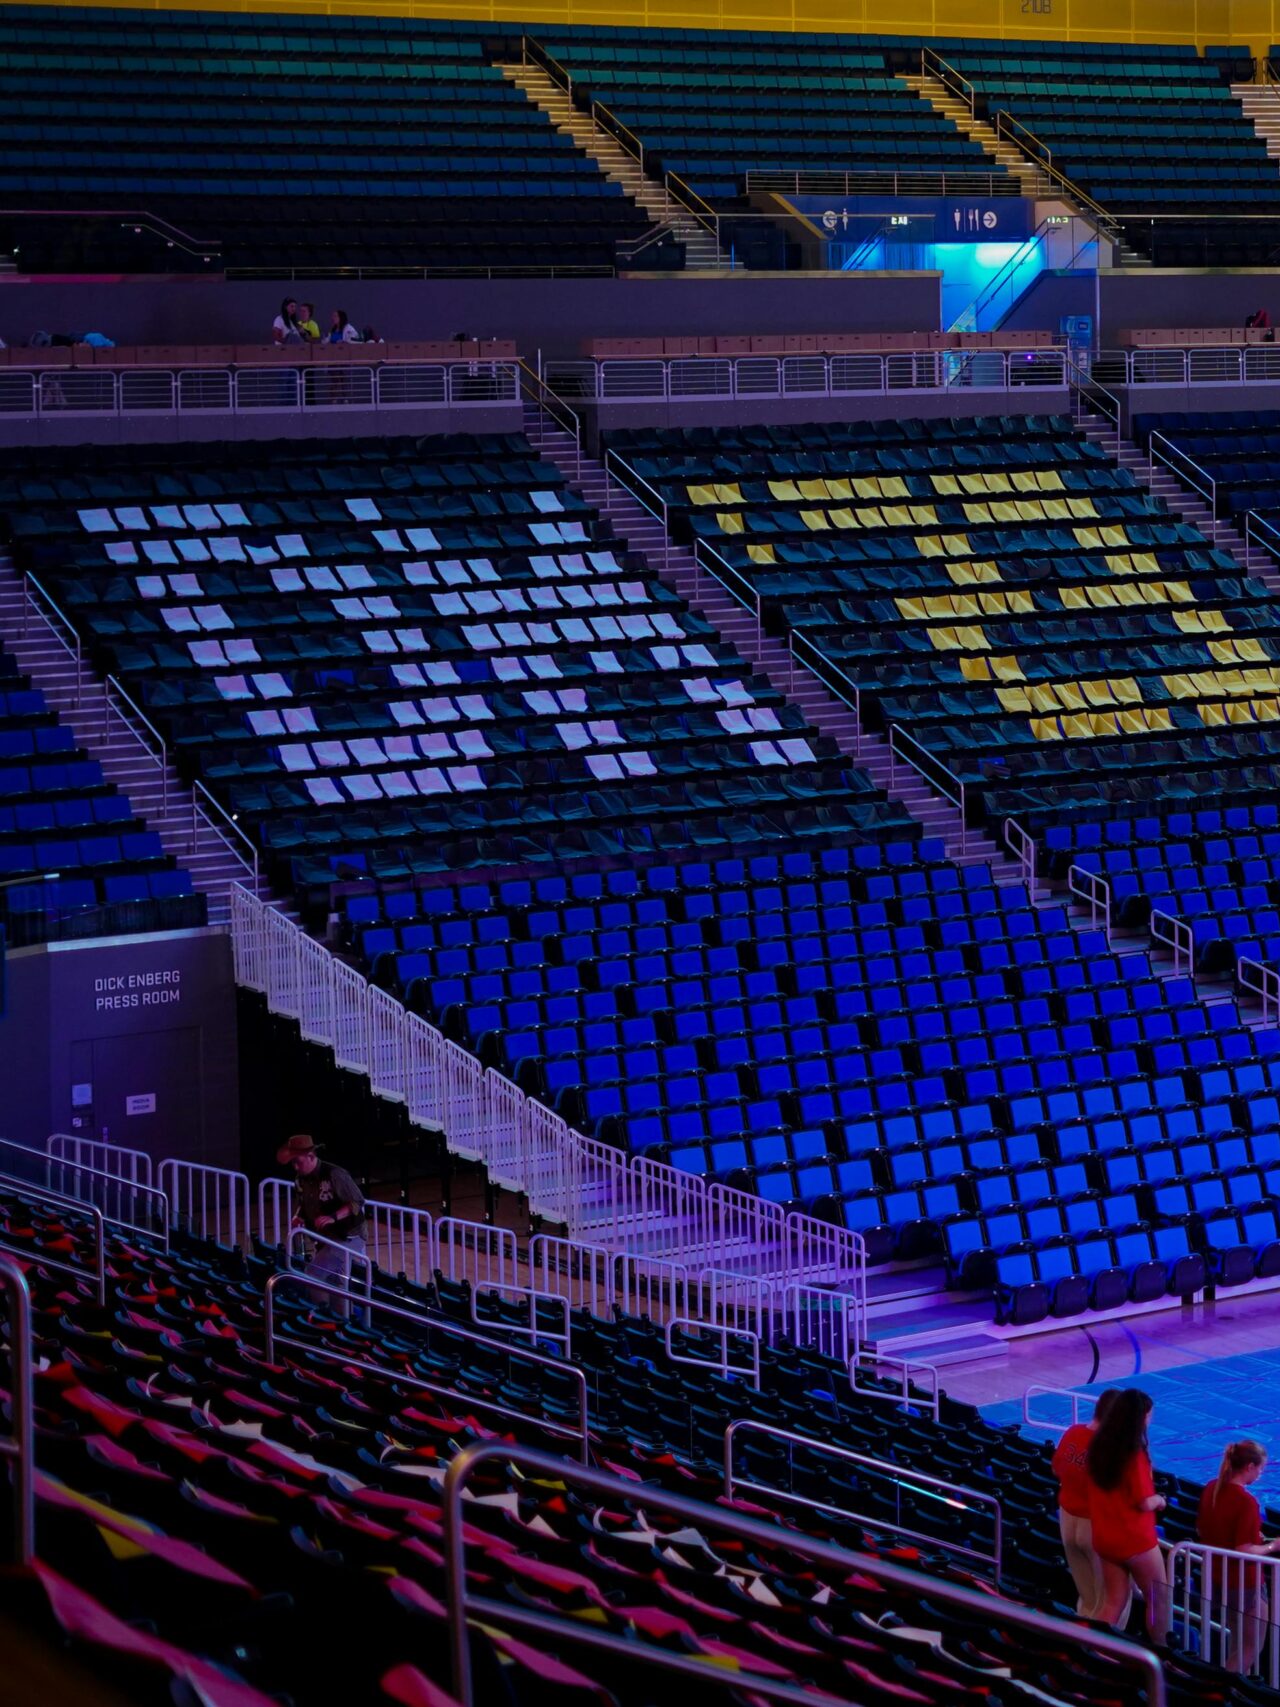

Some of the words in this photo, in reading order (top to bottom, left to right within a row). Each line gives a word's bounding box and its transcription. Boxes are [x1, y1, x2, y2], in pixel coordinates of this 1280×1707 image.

[95, 976, 125, 992] DICK
[128, 970, 181, 988] ENBERG
[96, 994, 139, 1011] PRESS
[142, 989, 180, 1006] ROOM
